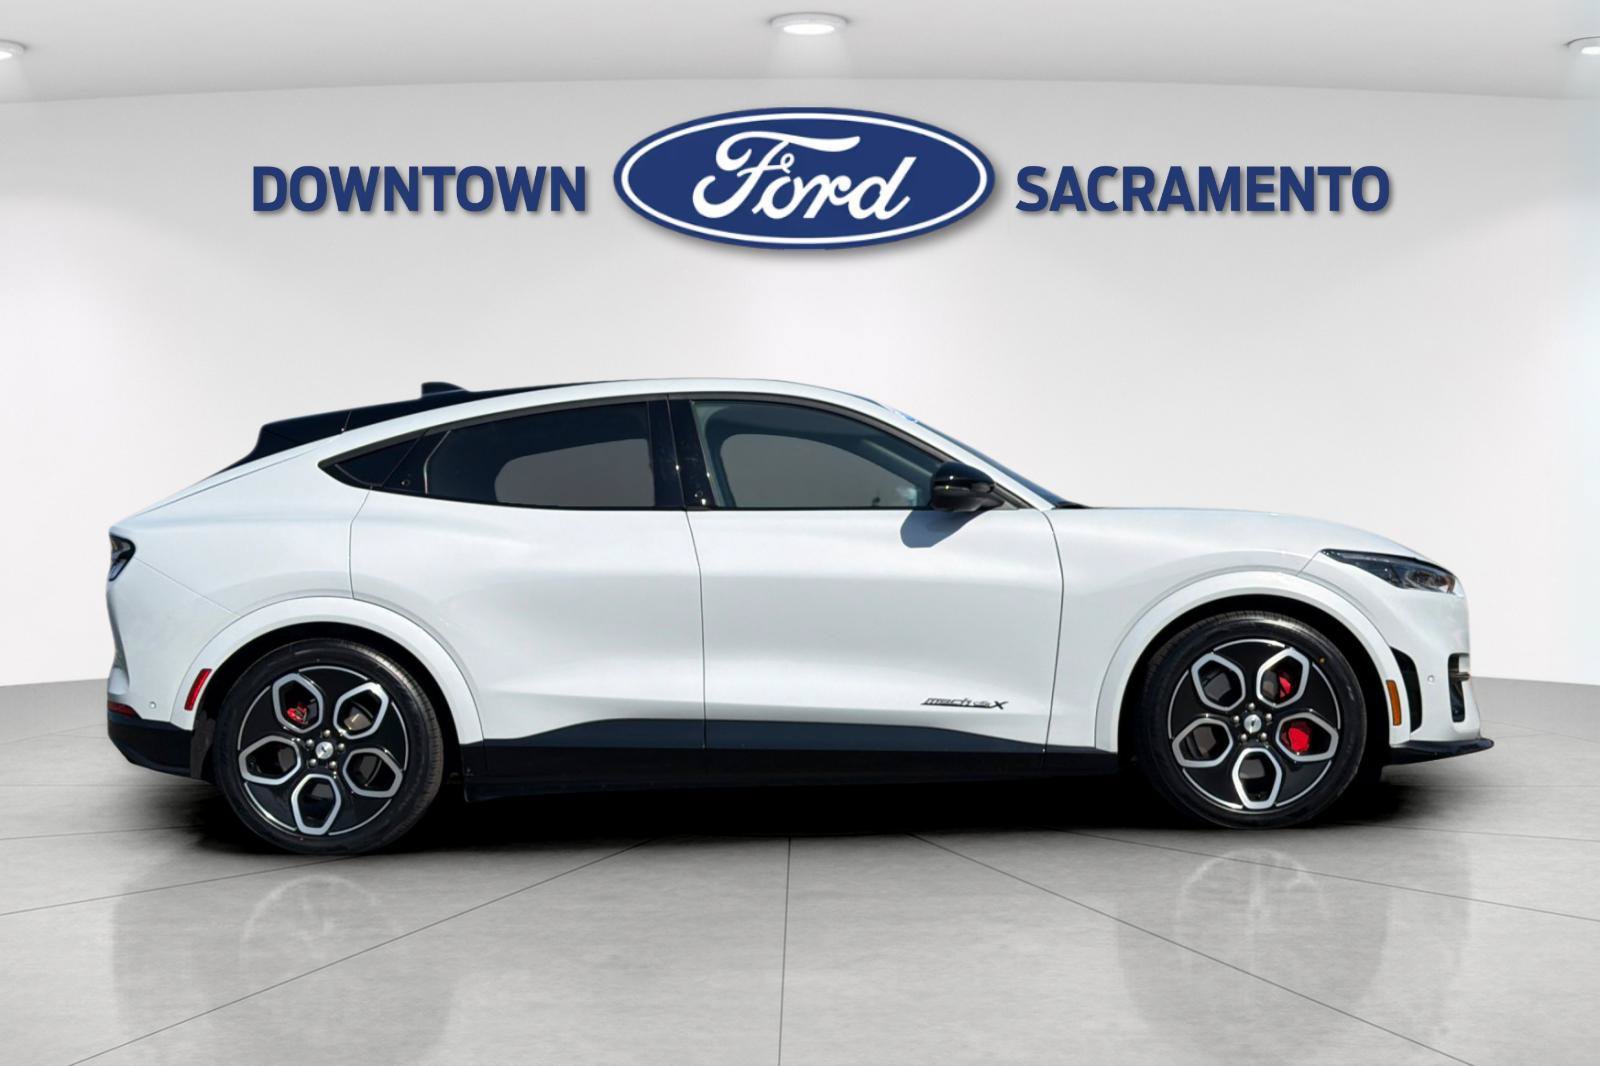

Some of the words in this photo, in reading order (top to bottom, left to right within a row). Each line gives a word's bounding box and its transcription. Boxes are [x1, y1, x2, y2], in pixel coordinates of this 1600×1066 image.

[252, 165, 587, 213] DOWNTOWN
[692, 131, 917, 220] Ford
[1016, 165, 1390, 214] SACRAMENTO
